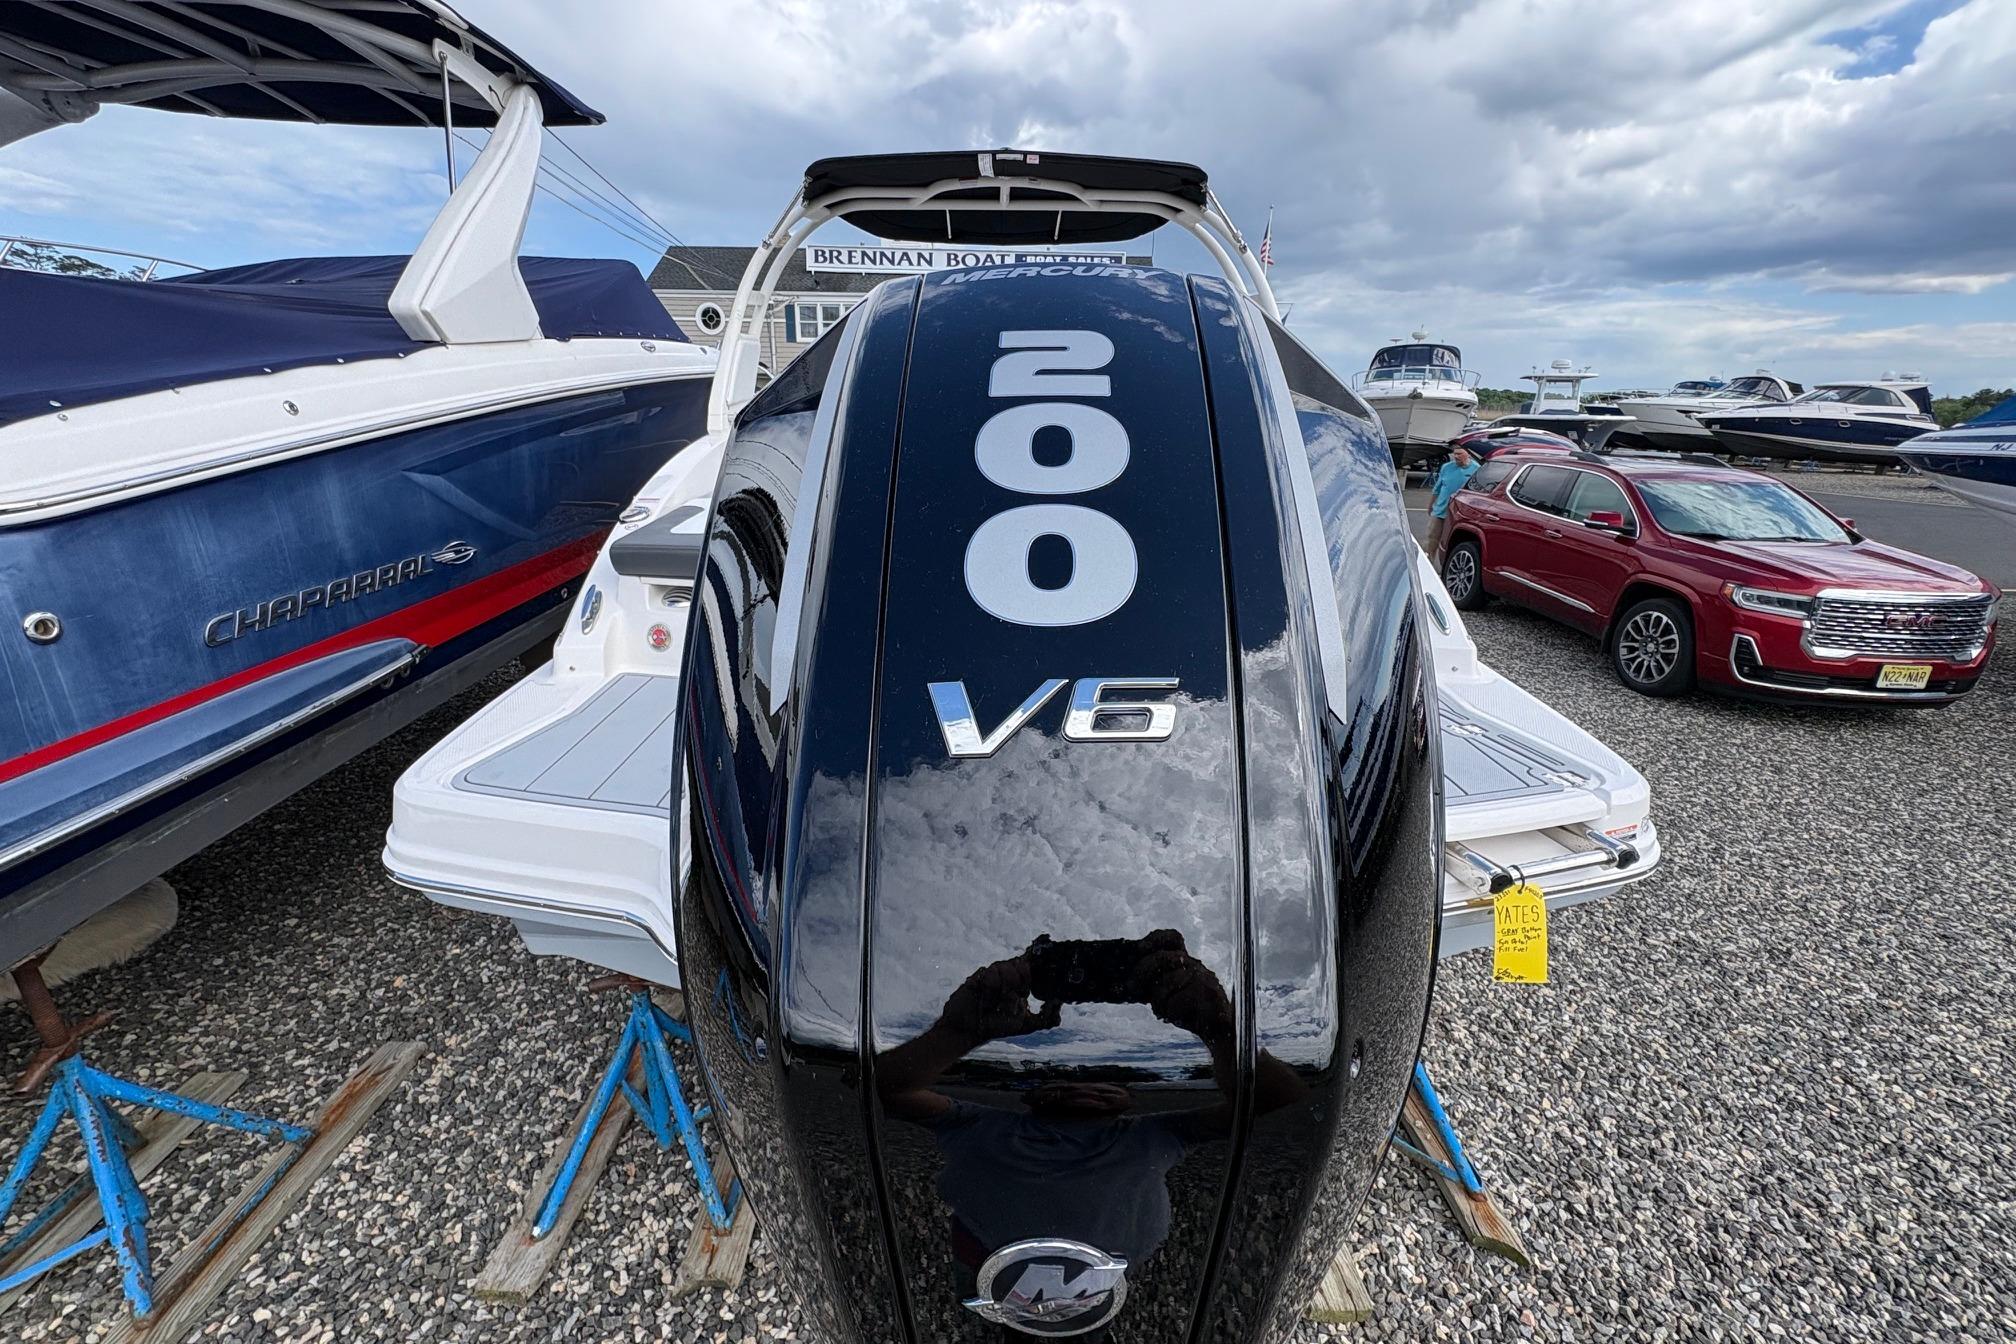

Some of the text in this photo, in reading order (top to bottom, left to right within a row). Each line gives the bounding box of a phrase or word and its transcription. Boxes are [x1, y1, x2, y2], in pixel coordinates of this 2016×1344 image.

[813, 249, 1011, 267] BRENNAN BOAT
[1026, 255, 1111, 264] BOAT SALES
[941, 265, 1165, 286] MERCURY
[964, 330, 1139, 627] 200
[203, 554, 434, 647] CHAPARRAL
[1886, 615, 1948, 628] GMC
[927, 677, 1180, 759] V6
[1496, 905, 1540, 924] YATES
